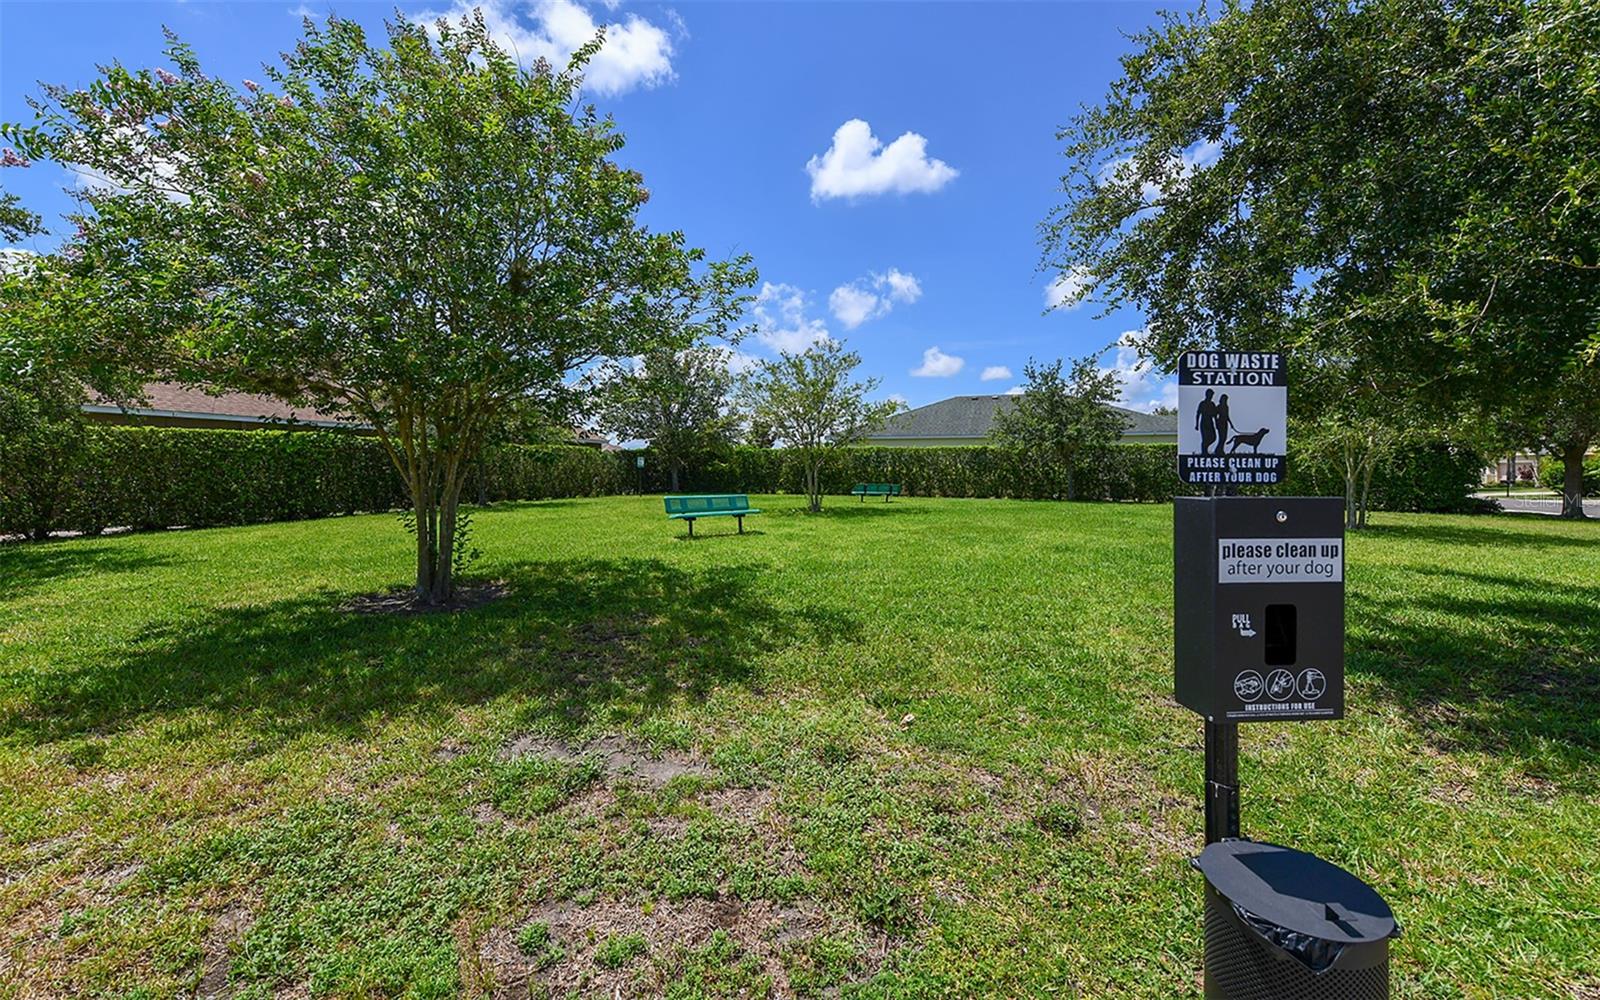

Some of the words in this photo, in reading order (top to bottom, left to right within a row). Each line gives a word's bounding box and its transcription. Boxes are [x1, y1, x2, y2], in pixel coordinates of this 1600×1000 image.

[1187, 353, 1219, 369] DOG
[1225, 353, 1279, 369] WASTE
[1192, 372, 1274, 385] STATION
[1187, 458, 1225, 468] PLEASE
[1228, 458, 1262, 468] CLEAN
[1264, 458, 1279, 468] UP
[1189, 471, 1220, 482] AFTER
[1224, 472, 1252, 482] YOUR
[1255, 472, 1277, 482] DOG
[1222, 543, 1272, 560] please
[1276, 543, 1316, 558] clean
[1321, 545, 1339, 559] up
[1227, 560, 1262, 575] after
[1266, 563, 1300, 578] your
[1304, 560, 1334, 577] dog
[1232, 613, 1250, 623] PULL
[1245, 703, 1290, 711] INSTRUCTIONS
[1303, 702, 1316, 710] USE
